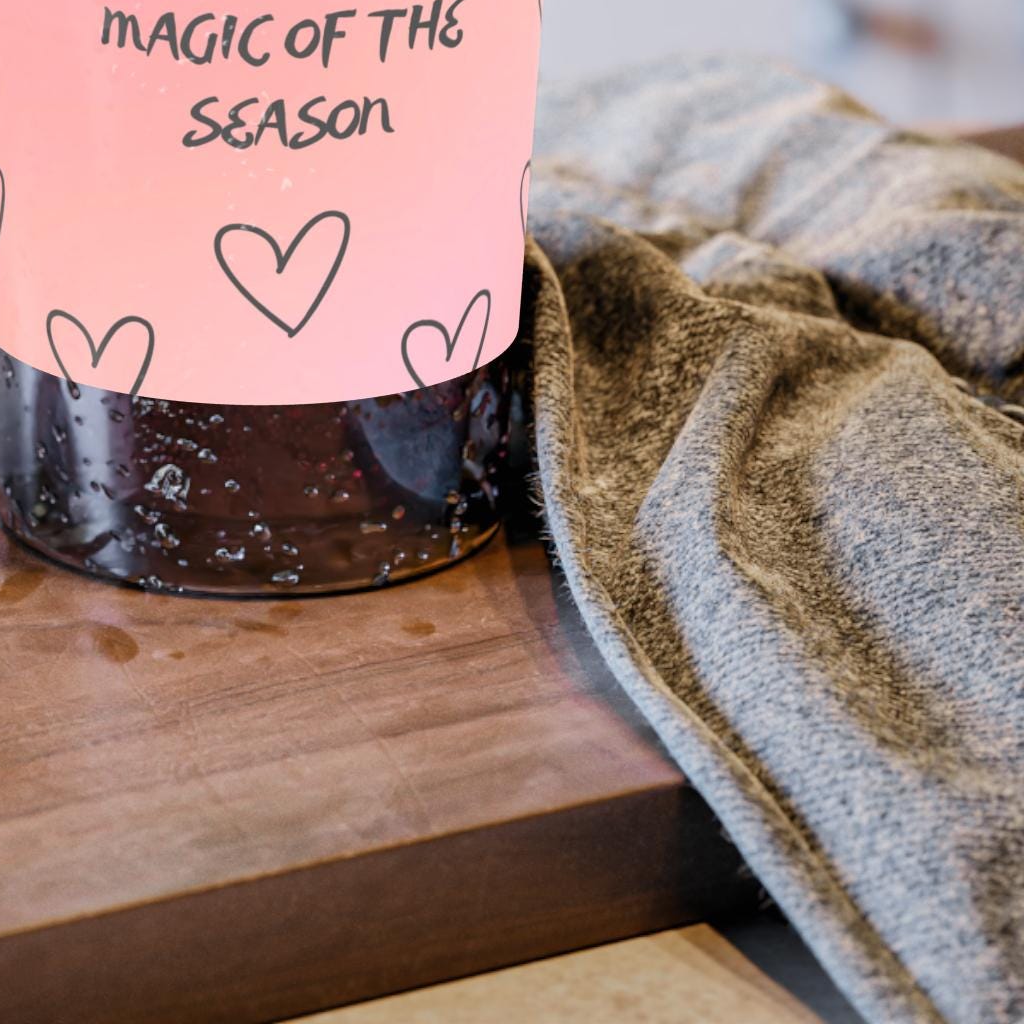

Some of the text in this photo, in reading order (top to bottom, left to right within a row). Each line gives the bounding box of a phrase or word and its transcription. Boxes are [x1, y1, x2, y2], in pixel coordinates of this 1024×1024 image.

[101, 6, 275, 68] MAGIC
[284, 9, 357, 69] OF
[182, 95, 395, 150] SEASON
